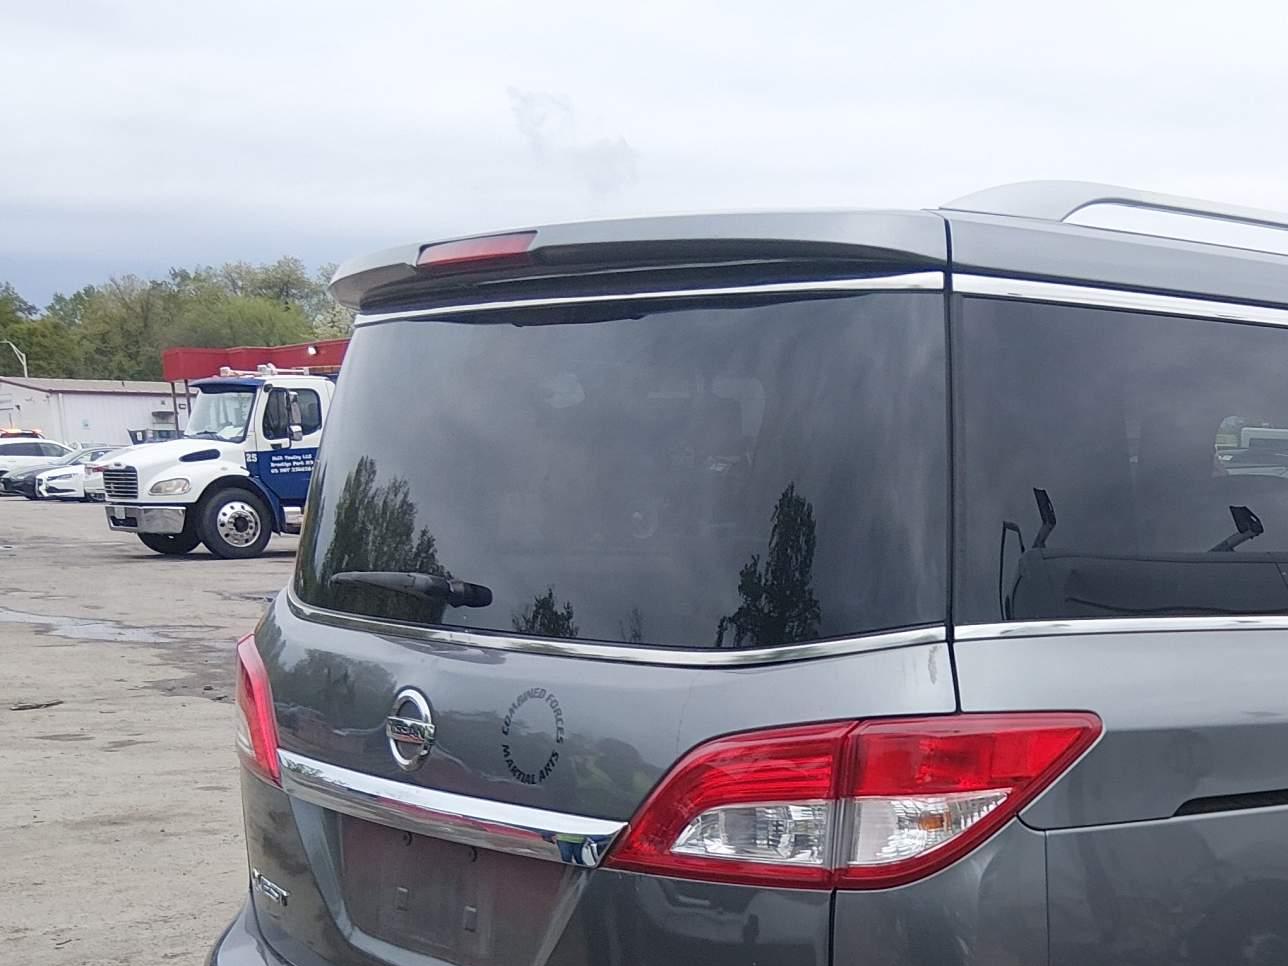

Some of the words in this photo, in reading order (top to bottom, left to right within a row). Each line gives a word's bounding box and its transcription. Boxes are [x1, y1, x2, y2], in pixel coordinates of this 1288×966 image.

[246, 453, 257, 462] 25
[545, 693, 564, 744] FORCES
[502, 744, 537, 785] MARTIAL
[538, 749, 560, 783] ARTS
